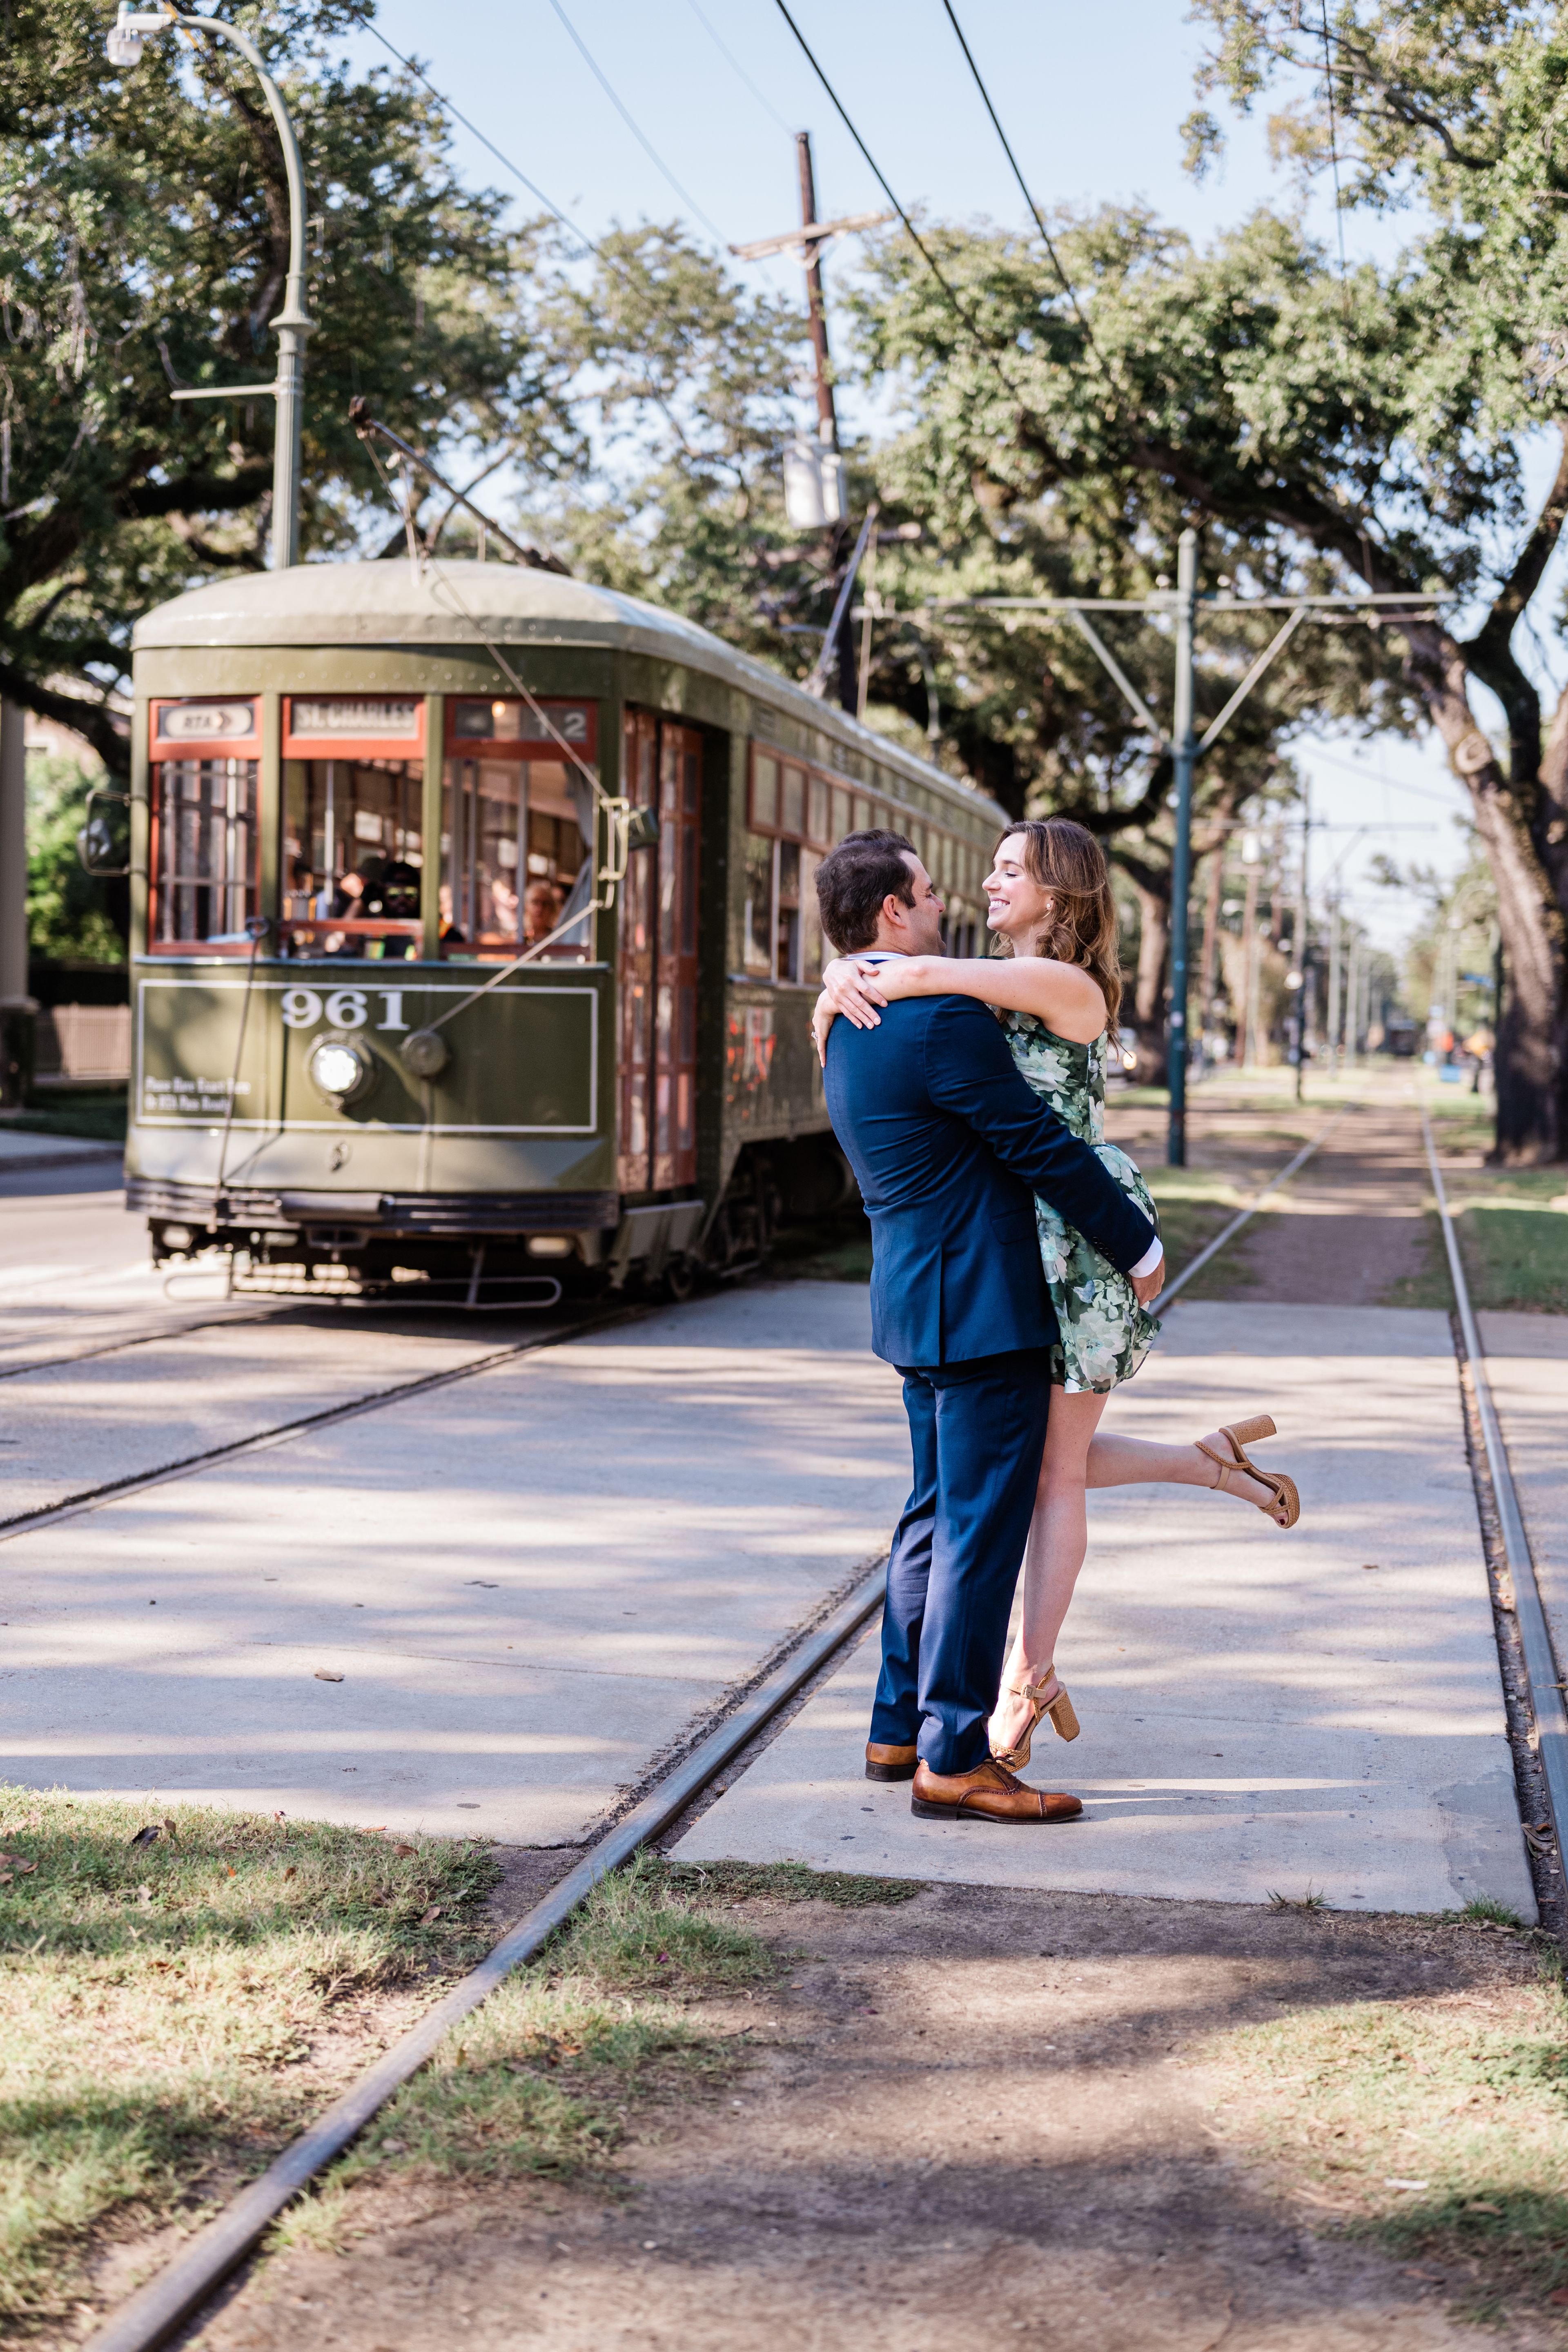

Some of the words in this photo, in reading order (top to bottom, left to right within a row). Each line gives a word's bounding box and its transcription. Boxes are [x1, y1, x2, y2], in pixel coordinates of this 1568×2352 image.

[183, 715, 212, 730] RTA
[327, 702, 414, 728] CHARLES
[281, 989, 411, 1030] 961
